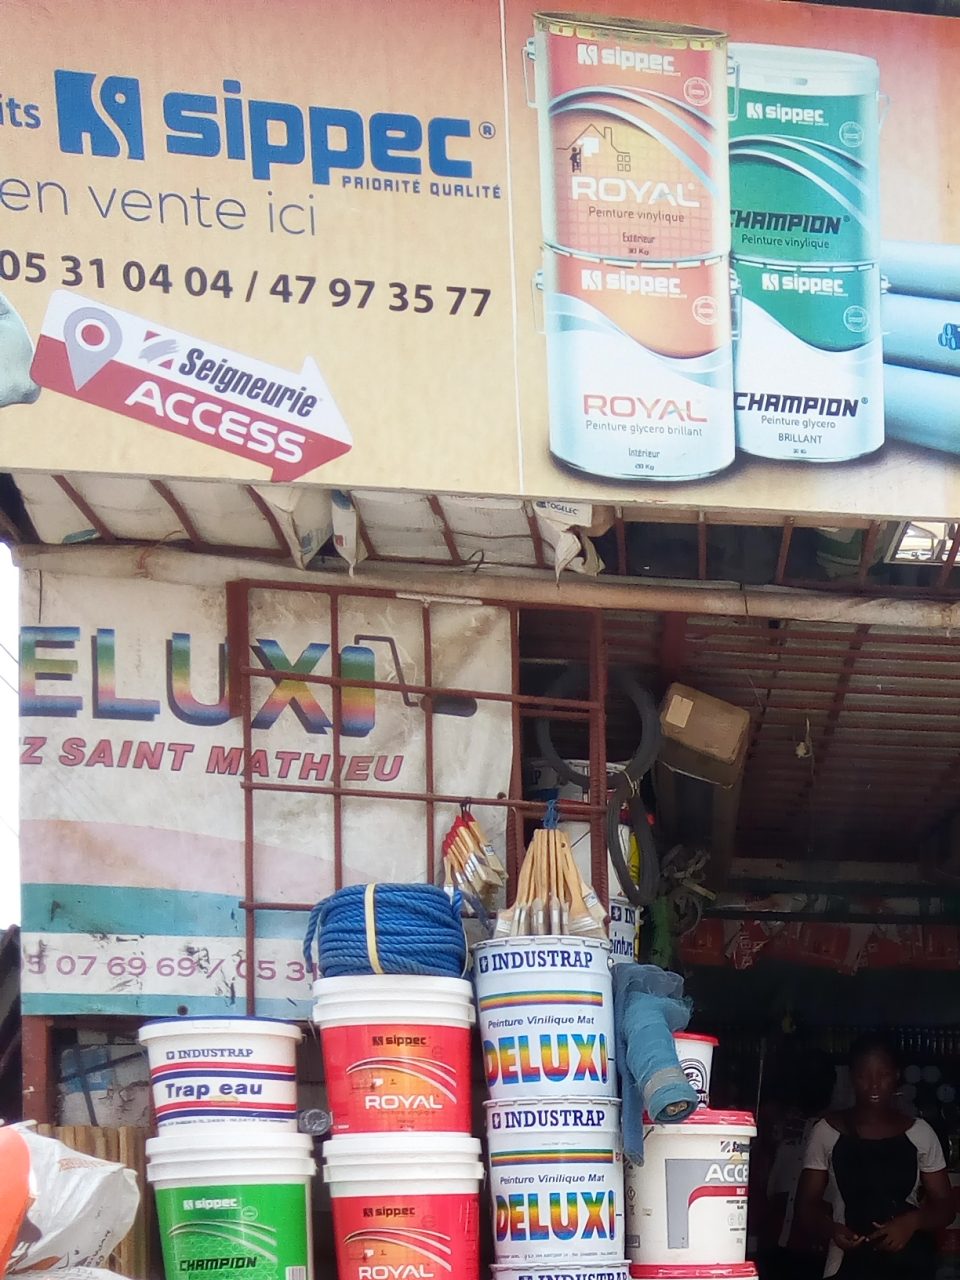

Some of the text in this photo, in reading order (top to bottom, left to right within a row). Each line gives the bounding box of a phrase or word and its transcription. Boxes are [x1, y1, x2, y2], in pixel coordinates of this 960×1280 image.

[766, 104, 824, 123] sippec
[342, 175, 501, 199] PRIORITÉ QUALITÉ
[572, 176, 700, 208] ROYAL
[0, 179, 315, 235] en vente ici
[589, 206, 685, 224] Peinture vinylique
[741, 234, 829, 250] Peinture vinylique
[0, 249, 492, 317] 05 31 04 04 / 47 97 35 77
[782, 273, 844, 295] sippec
[178, 348, 318, 417] Seigneurie
[583, 394, 707, 423] ROYAL
[124, 381, 306, 463] ACCESS
[586, 420, 627, 432] Peinture
[667, 425, 702, 437] brillant
[761, 415, 800, 426] Peinture
[778, 433, 822, 444] BRILLANT
[19, 736, 47, 765] Z
[59, 737, 193, 771] SAINT
[56, 956, 96, 976] 07
[107, 956, 147, 977] 69
[156, 957, 196, 978] 69
[491, 950, 593, 971] INDUSTRAP
[577, 1015, 595, 1025] Mat
[385, 1035, 427, 1046] sippec
[178, 1048, 254, 1060] INDUSTRAP
[165, 1083, 263, 1099] Trap eau
[364, 1094, 443, 1110] ROYAL
[505, 1109, 605, 1129] INDUSTRAP
[588, 1173, 605, 1183] Mat
[195, 1197, 237, 1210] sippec
[375, 1206, 415, 1218] sippec
[179, 1256, 258, 1272] CHAMPION
[358, 1264, 434, 1280] ROYAL
